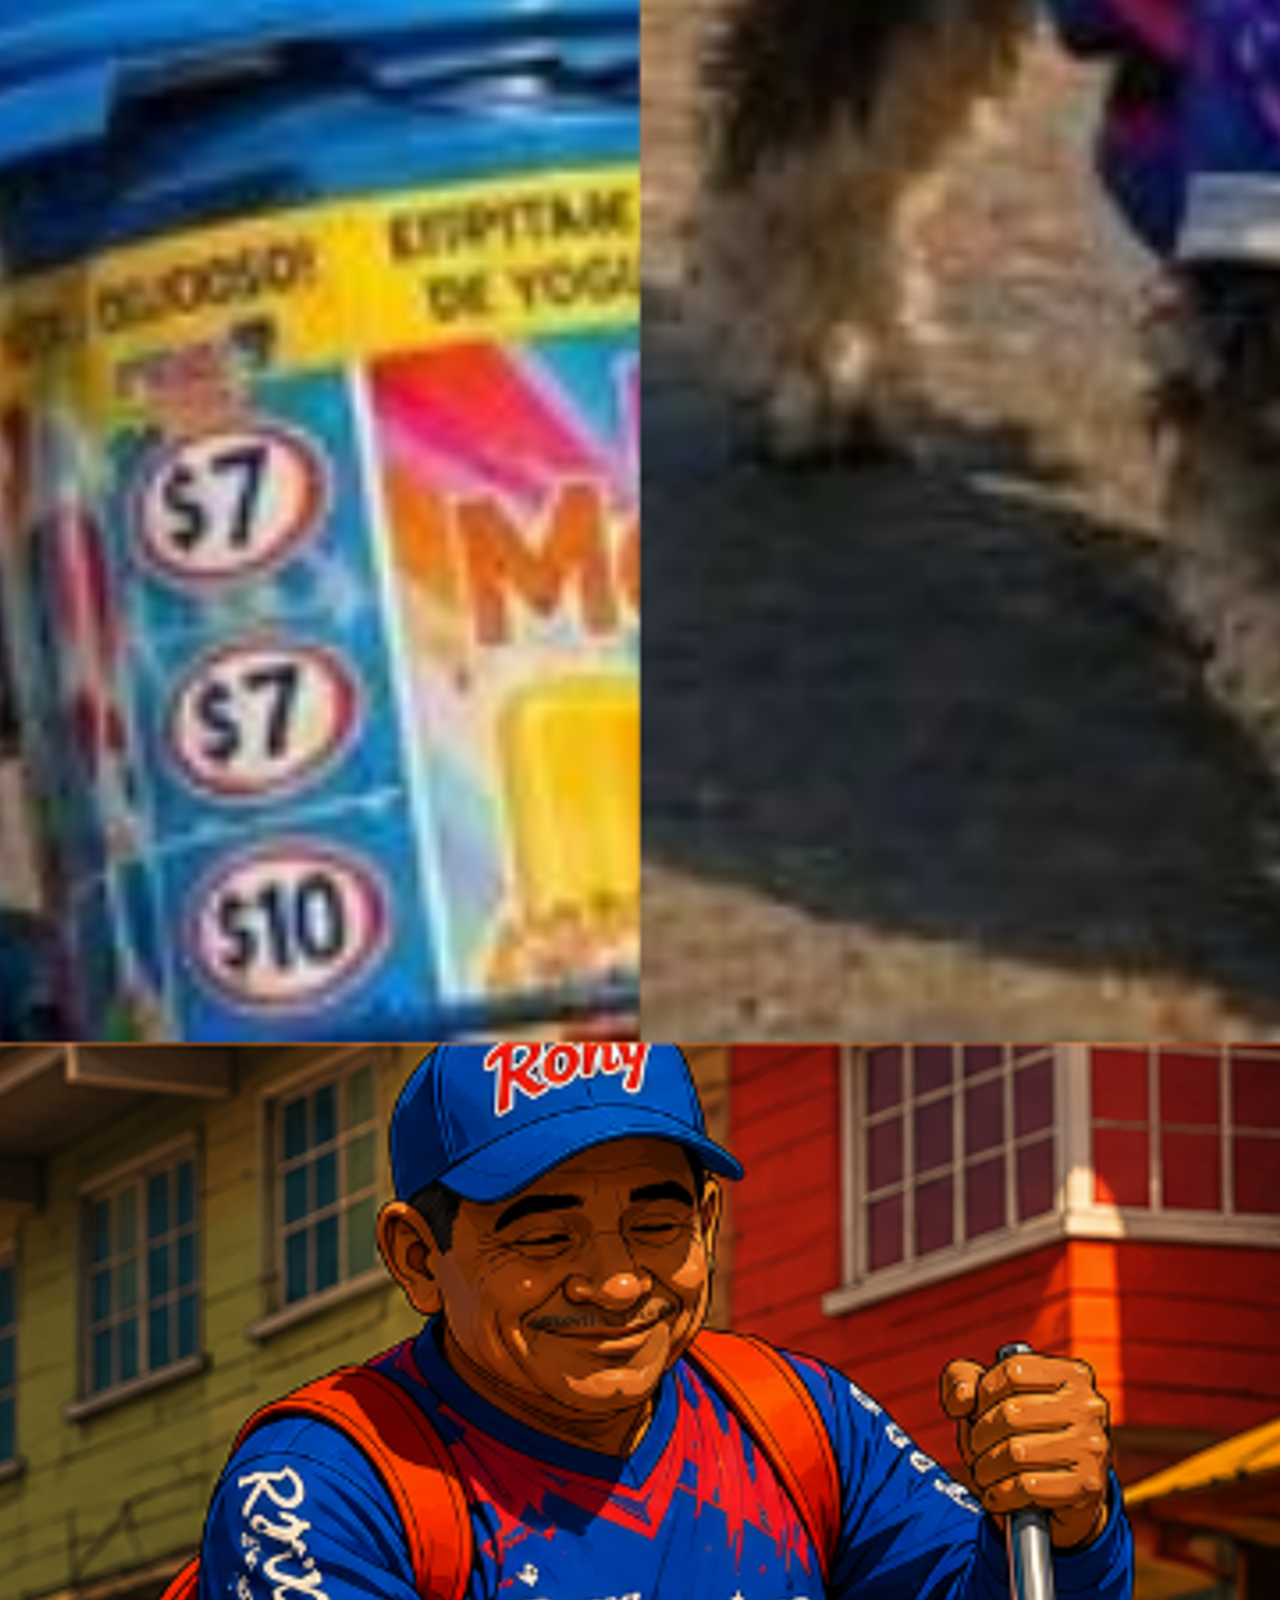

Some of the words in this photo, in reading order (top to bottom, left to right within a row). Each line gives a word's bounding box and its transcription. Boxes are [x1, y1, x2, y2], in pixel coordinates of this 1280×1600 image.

[162, 444, 268, 554] $7
[196, 662, 302, 762] $7
[218, 874, 346, 972] $10
[484, 1042, 651, 1117] Rony
